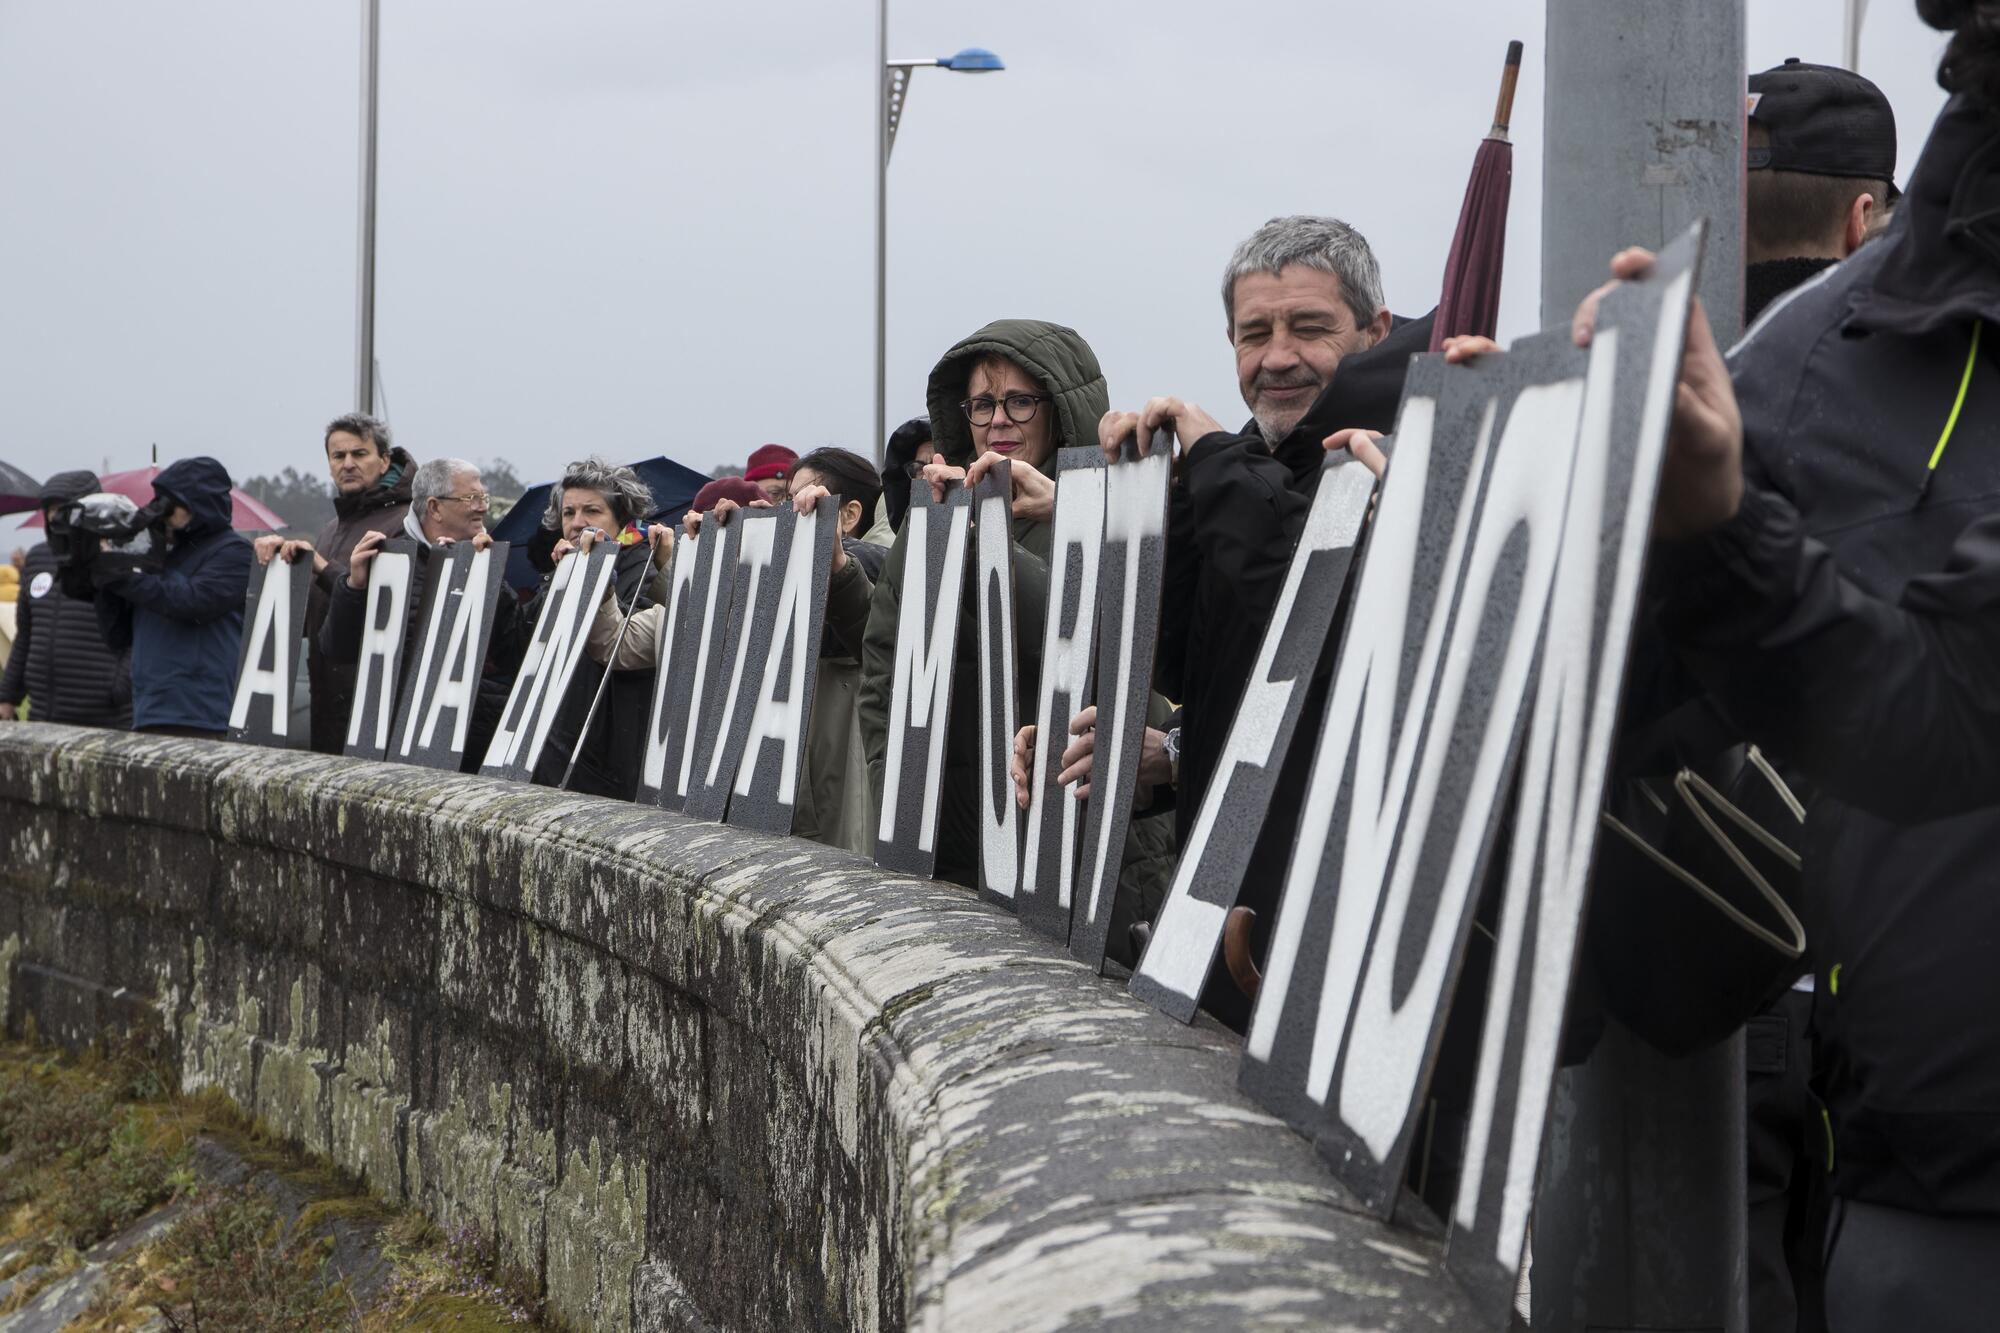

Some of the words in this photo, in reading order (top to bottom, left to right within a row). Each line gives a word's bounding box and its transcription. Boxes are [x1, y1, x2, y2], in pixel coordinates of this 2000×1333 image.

[229, 552, 290, 737] A
[347, 548, 491, 757] RIA
[483, 552, 618, 772] EN
[878, 455, 1377, 1000] MORTE
[1246, 268, 1692, 1272] NON
